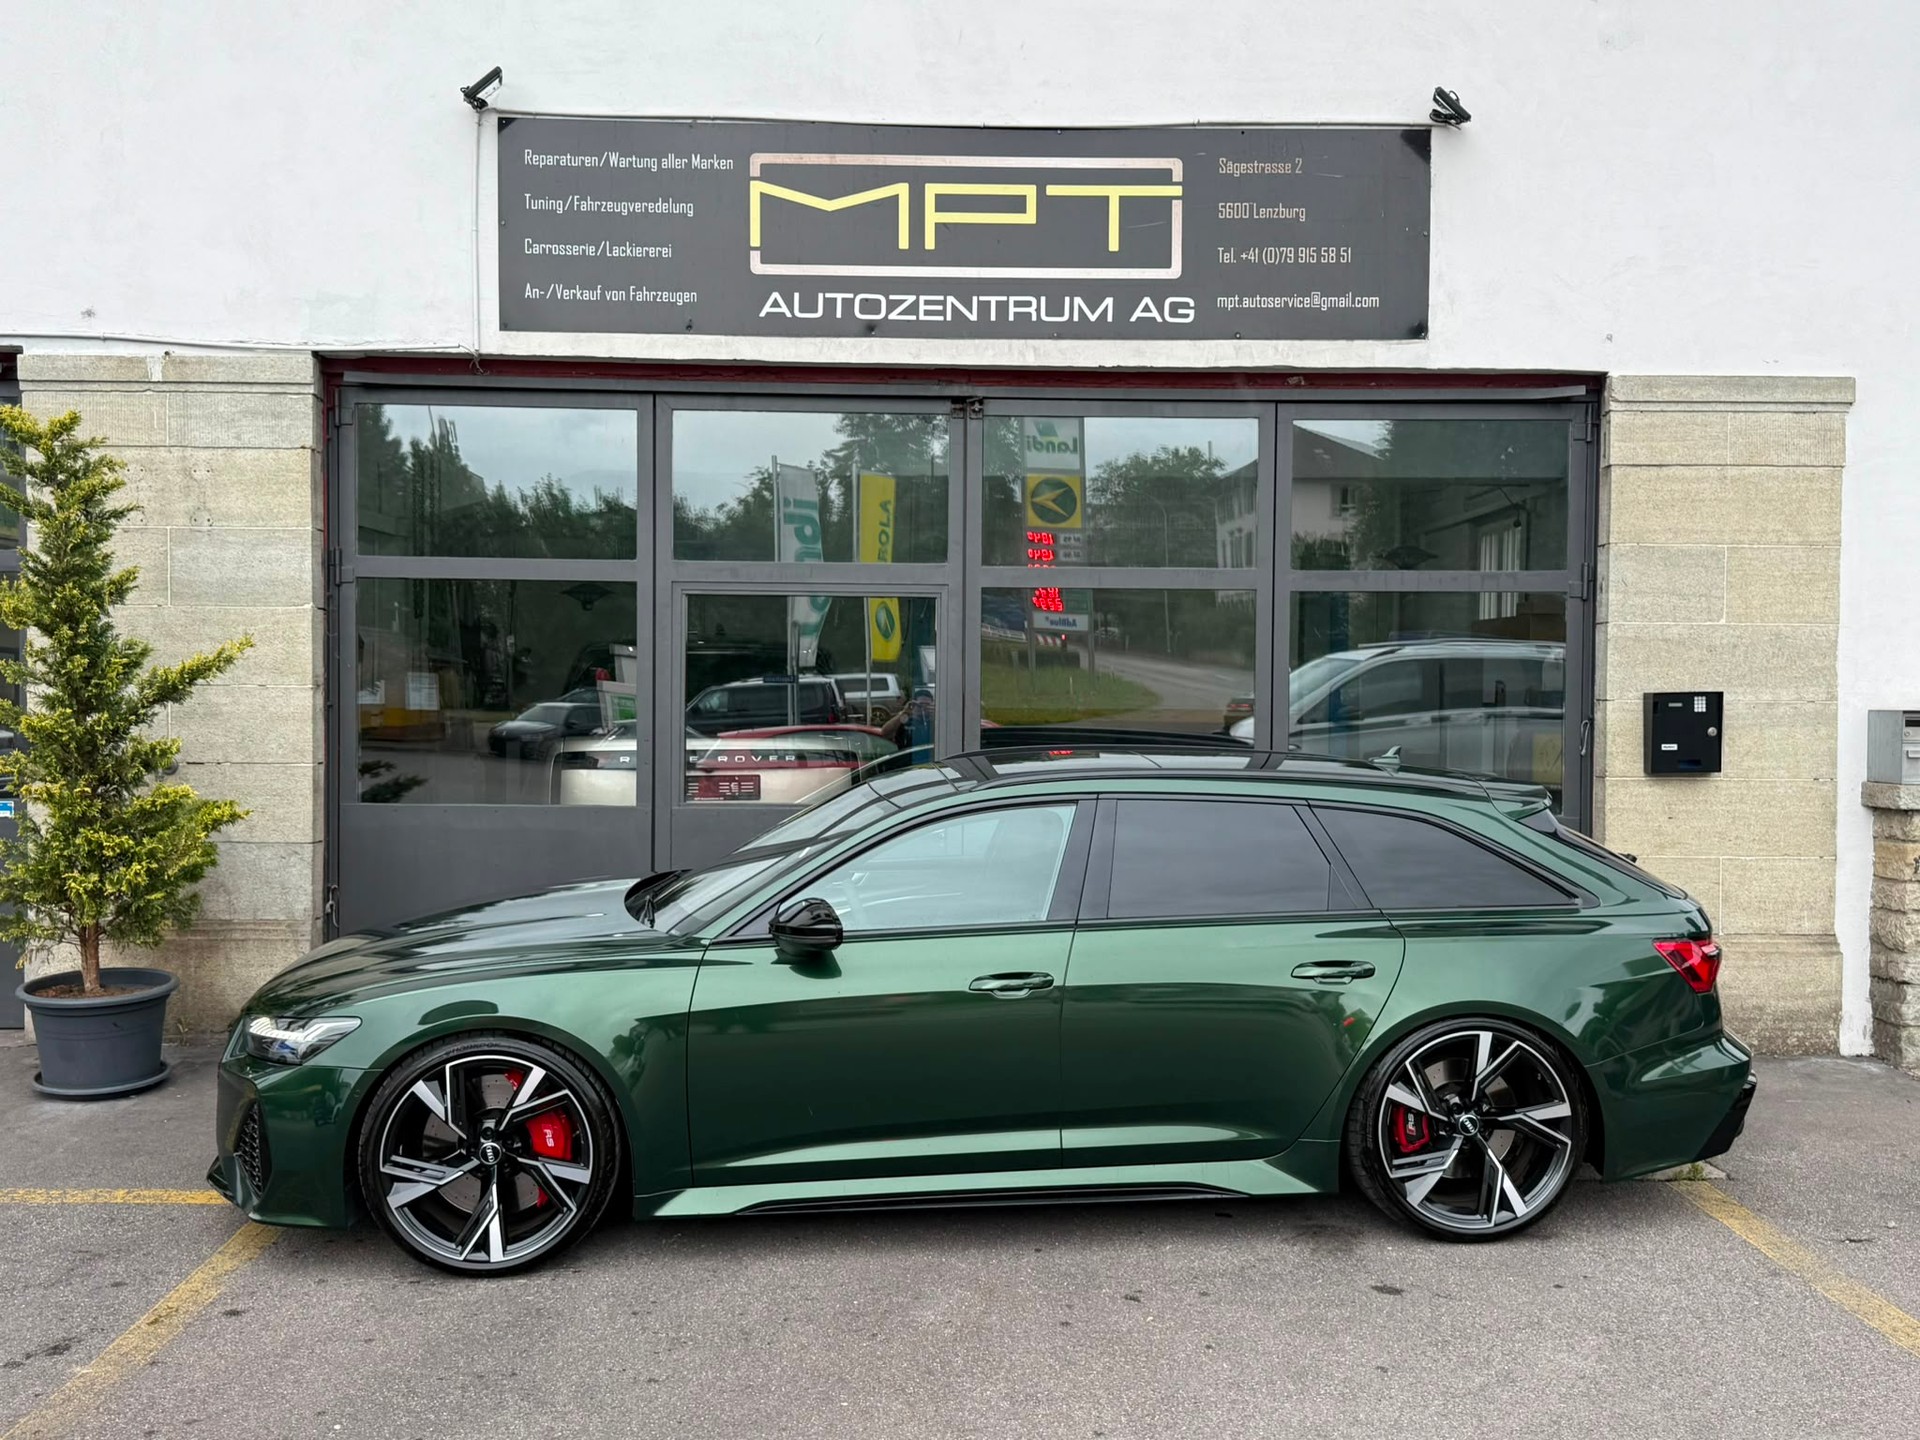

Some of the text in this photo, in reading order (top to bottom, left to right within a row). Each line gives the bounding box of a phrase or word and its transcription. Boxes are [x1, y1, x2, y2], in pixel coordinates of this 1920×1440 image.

[524, 148, 734, 172] Reparaturen/Wartung aller Marken
[1218, 157, 1303, 178] Sägestrasse 2
[524, 193, 694, 217] Tuning/Fahrzeugveredelung
[1218, 202, 1306, 222] 5600 Lenzburg
[750, 180, 1183, 252] MPT
[524, 238, 672, 259] Carrosserie/Lackiererei
[1217, 246, 1352, 265] Tel. +41 (0)79 915 58 51
[524, 282, 698, 306] An-/Verkauf von Fahrzeugen
[1216, 291, 1380, 312] mpt.autoservice@gmail.com
[759, 291, 1196, 324] AUTOZENTRUM AG
[717, 755, 796, 763] ROVER
[543, 1128, 555, 1147] RS
